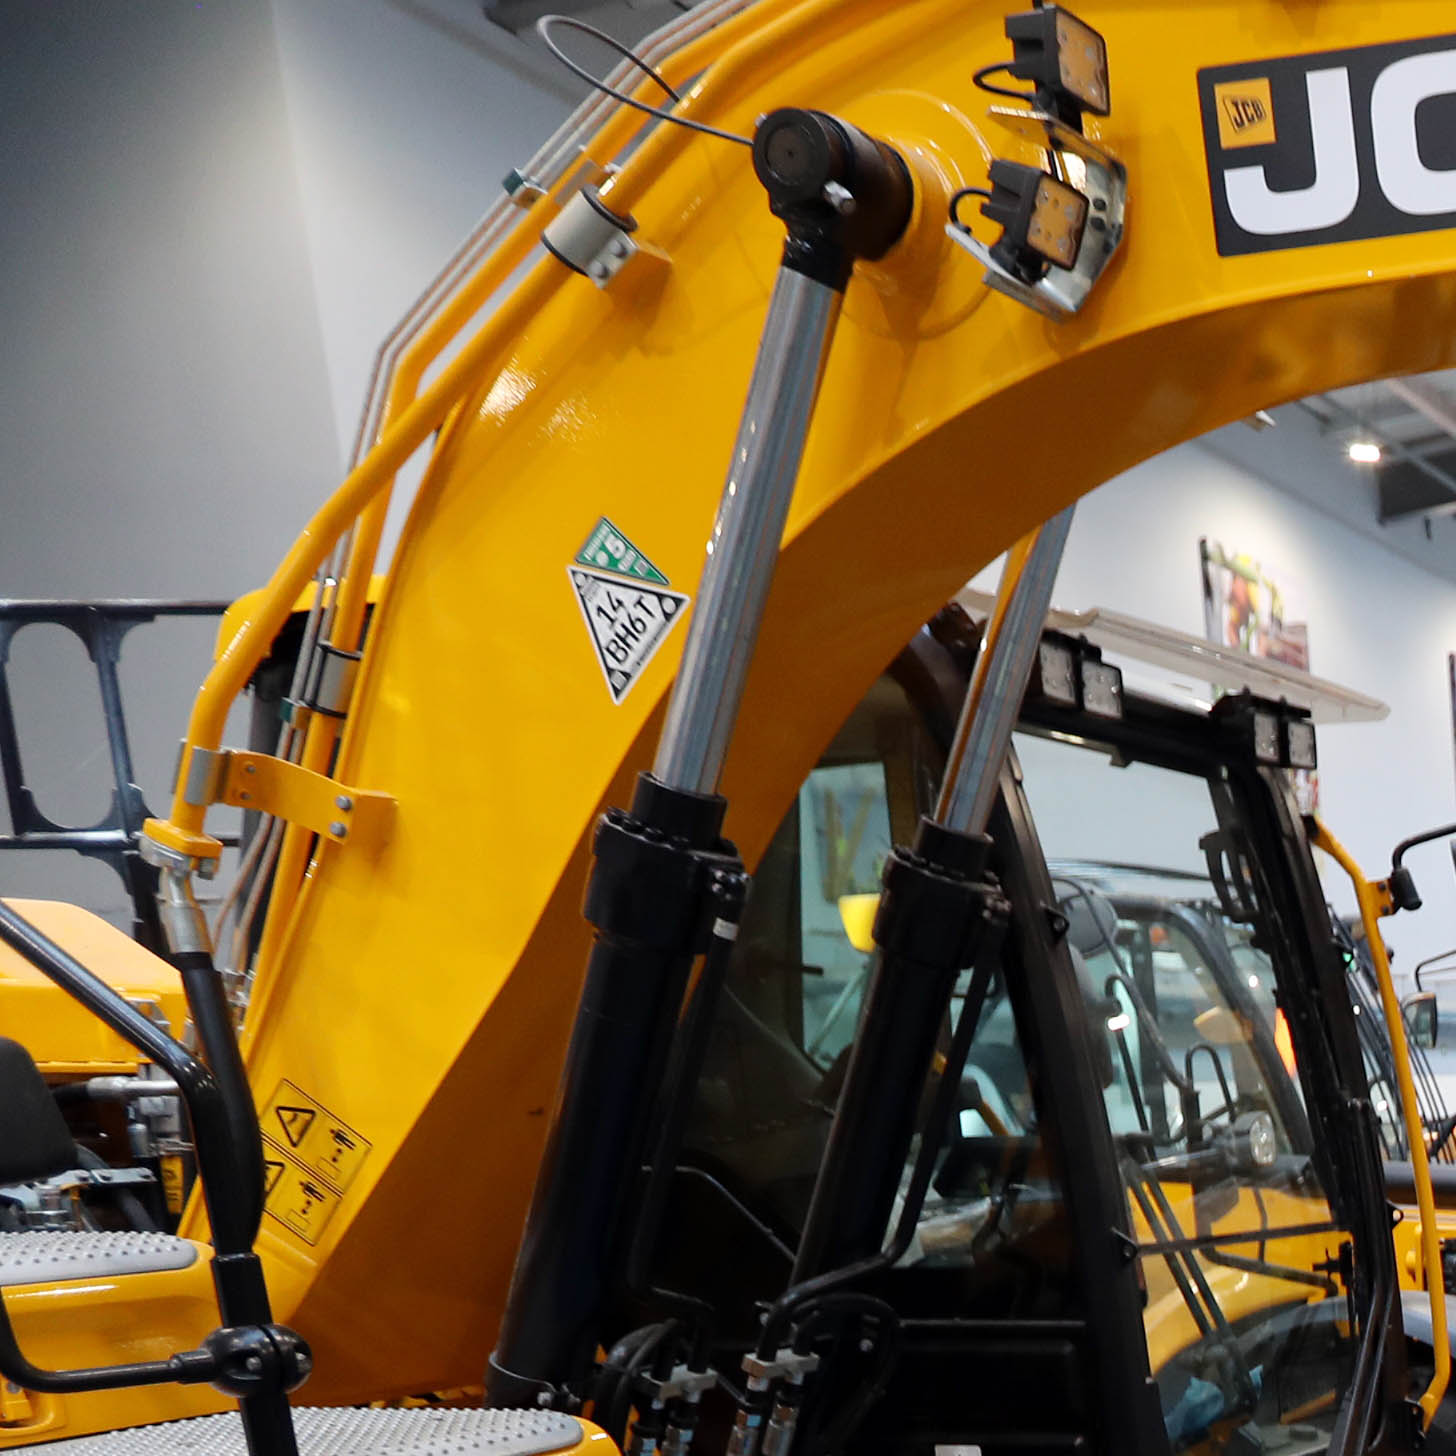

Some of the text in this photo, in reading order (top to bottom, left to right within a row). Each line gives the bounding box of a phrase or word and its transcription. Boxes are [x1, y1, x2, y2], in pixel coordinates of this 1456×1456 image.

[1230, 98, 1266, 129] JCB
[596, 591, 627, 629] 14
[604, 595, 655, 664] BH6T
